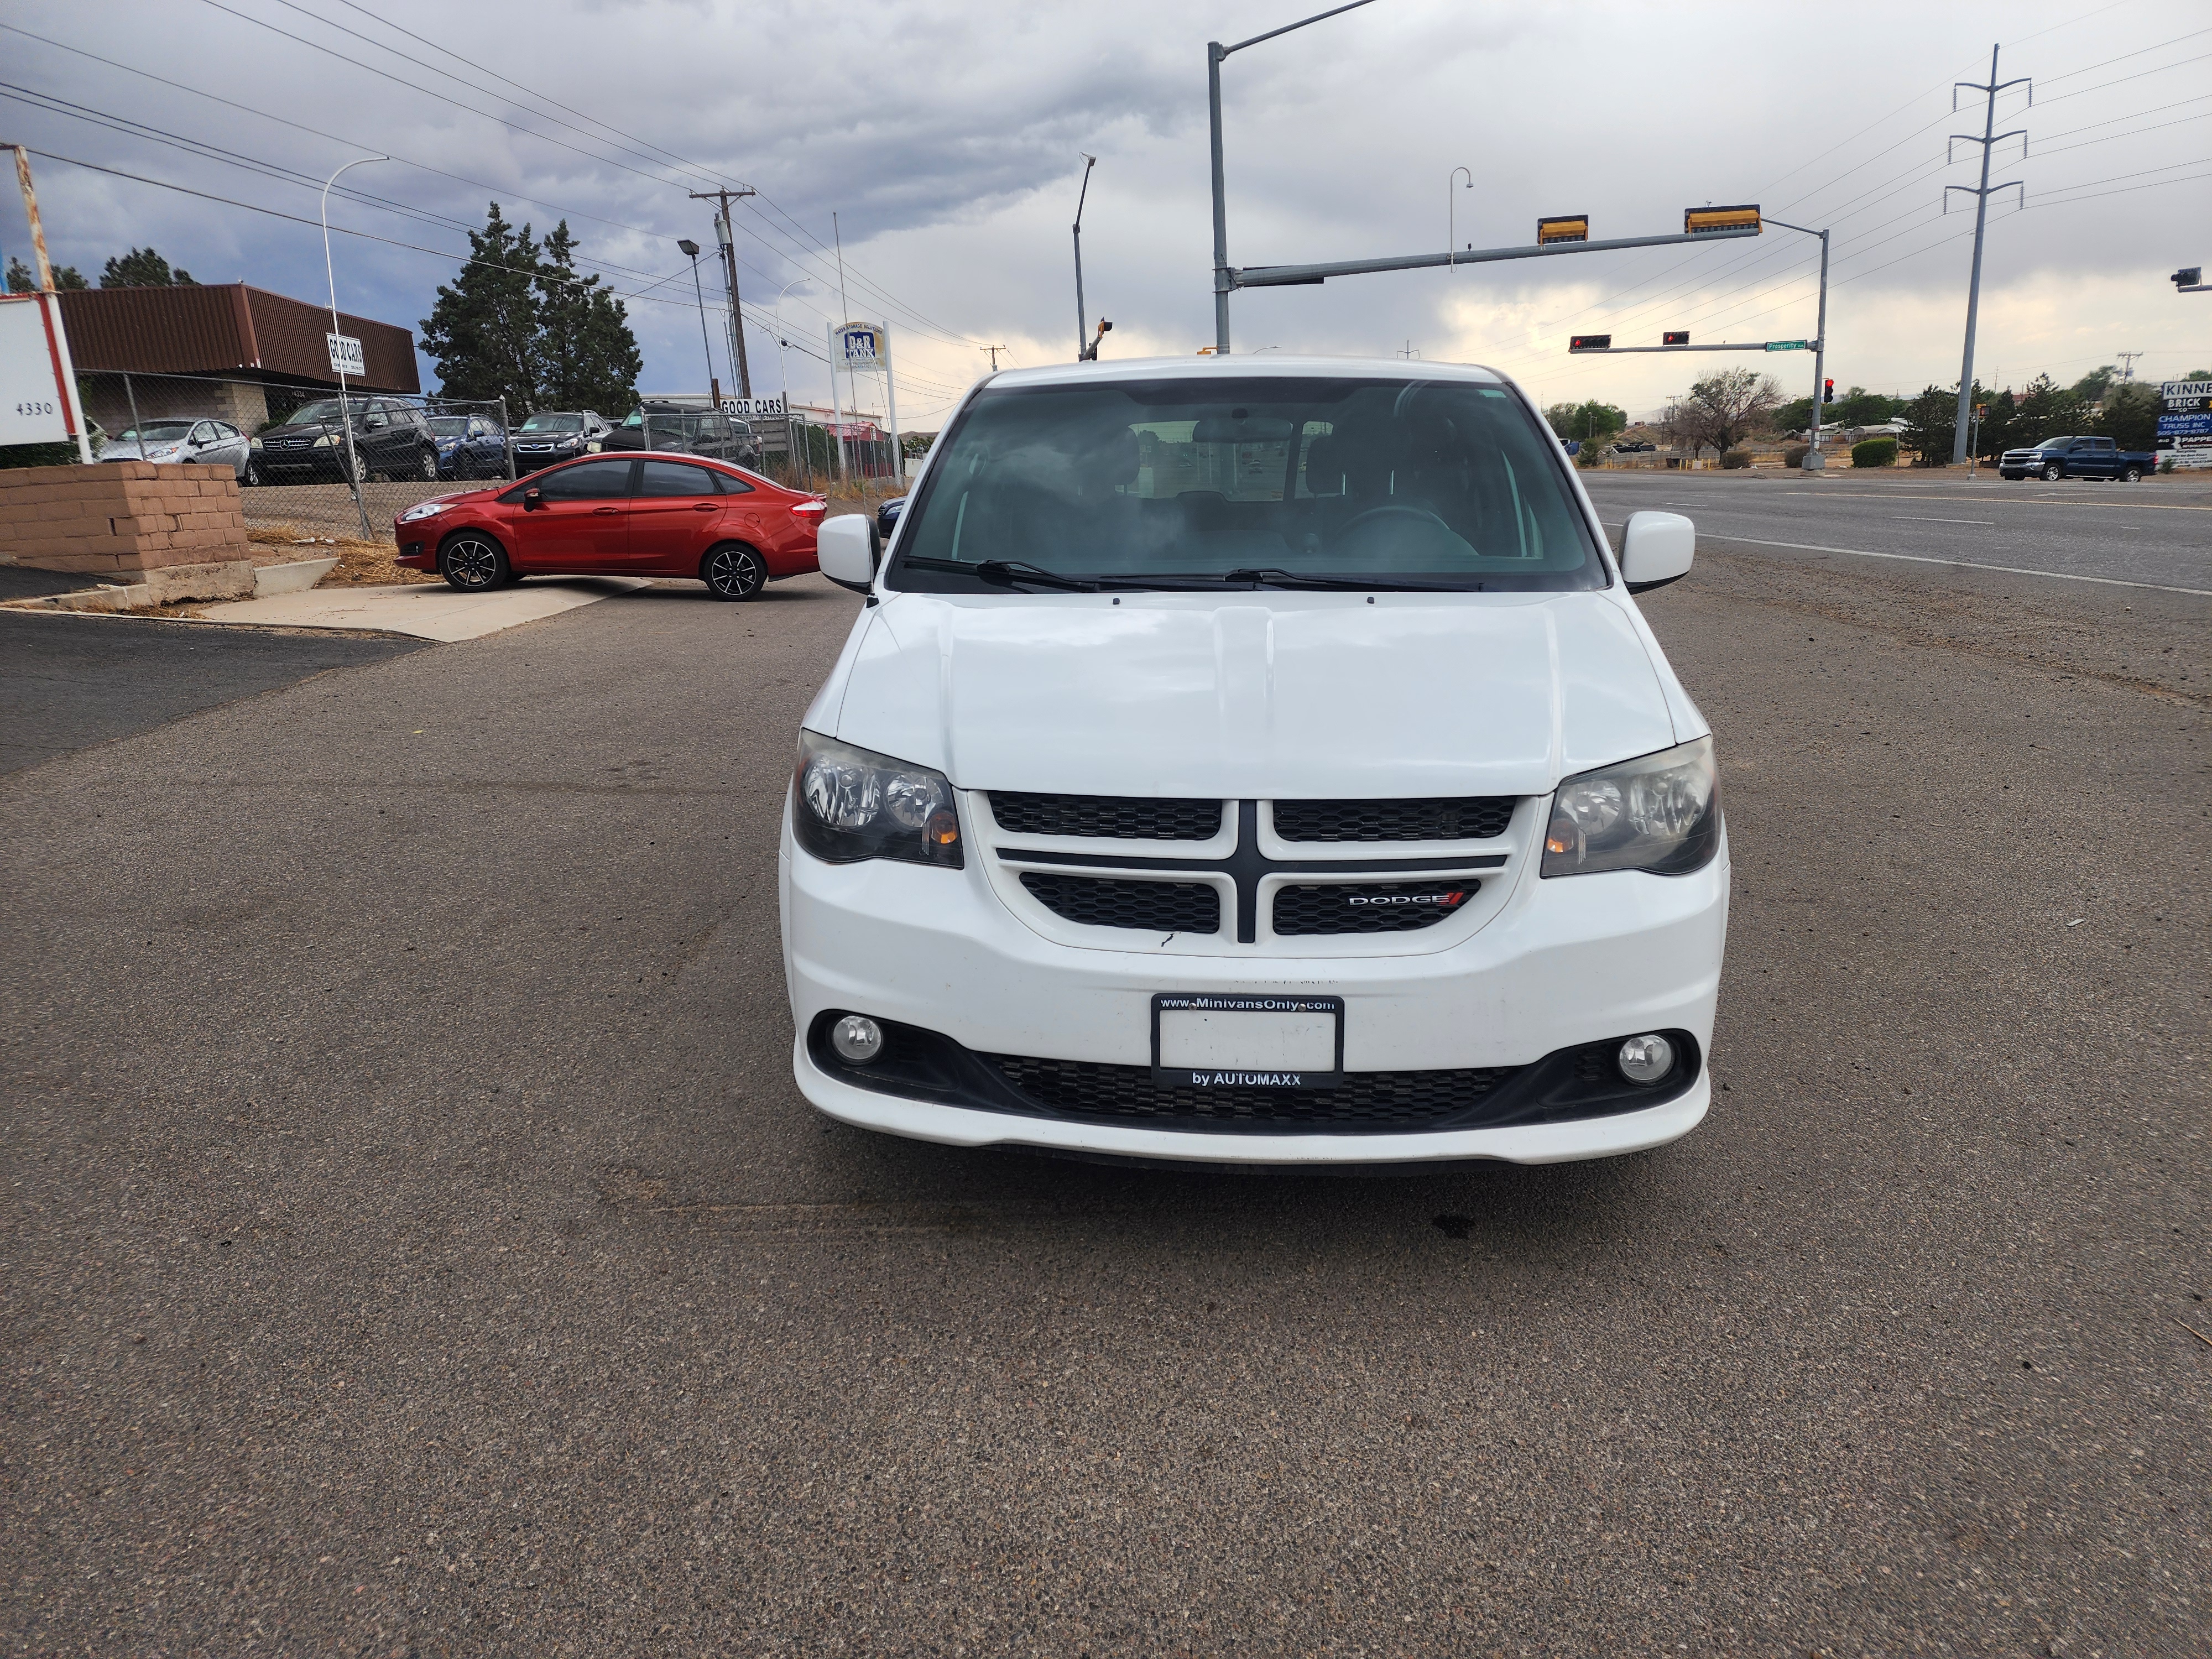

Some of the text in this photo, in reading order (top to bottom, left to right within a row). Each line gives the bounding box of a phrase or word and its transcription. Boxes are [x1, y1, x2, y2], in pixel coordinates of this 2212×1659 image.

[864, 324, 883, 335] SOLUTIONS
[849, 335, 871, 349] D&R
[347, 342, 362, 363] CARS
[846, 349, 874, 358] TANK
[2167, 383, 2212, 395] KINNE
[16, 402, 53, 416] 4330
[722, 399, 781, 414] GOOD CARS
[2167, 398, 2200, 408] BRICK
[2158, 413, 2210, 423] CHAMPION
[1349, 895, 1450, 905] DODGE
[1161, 998, 1335, 1011] wwwMinivansOnlycom
[1192, 1072, 1301, 1087] by AUTOMAXX
